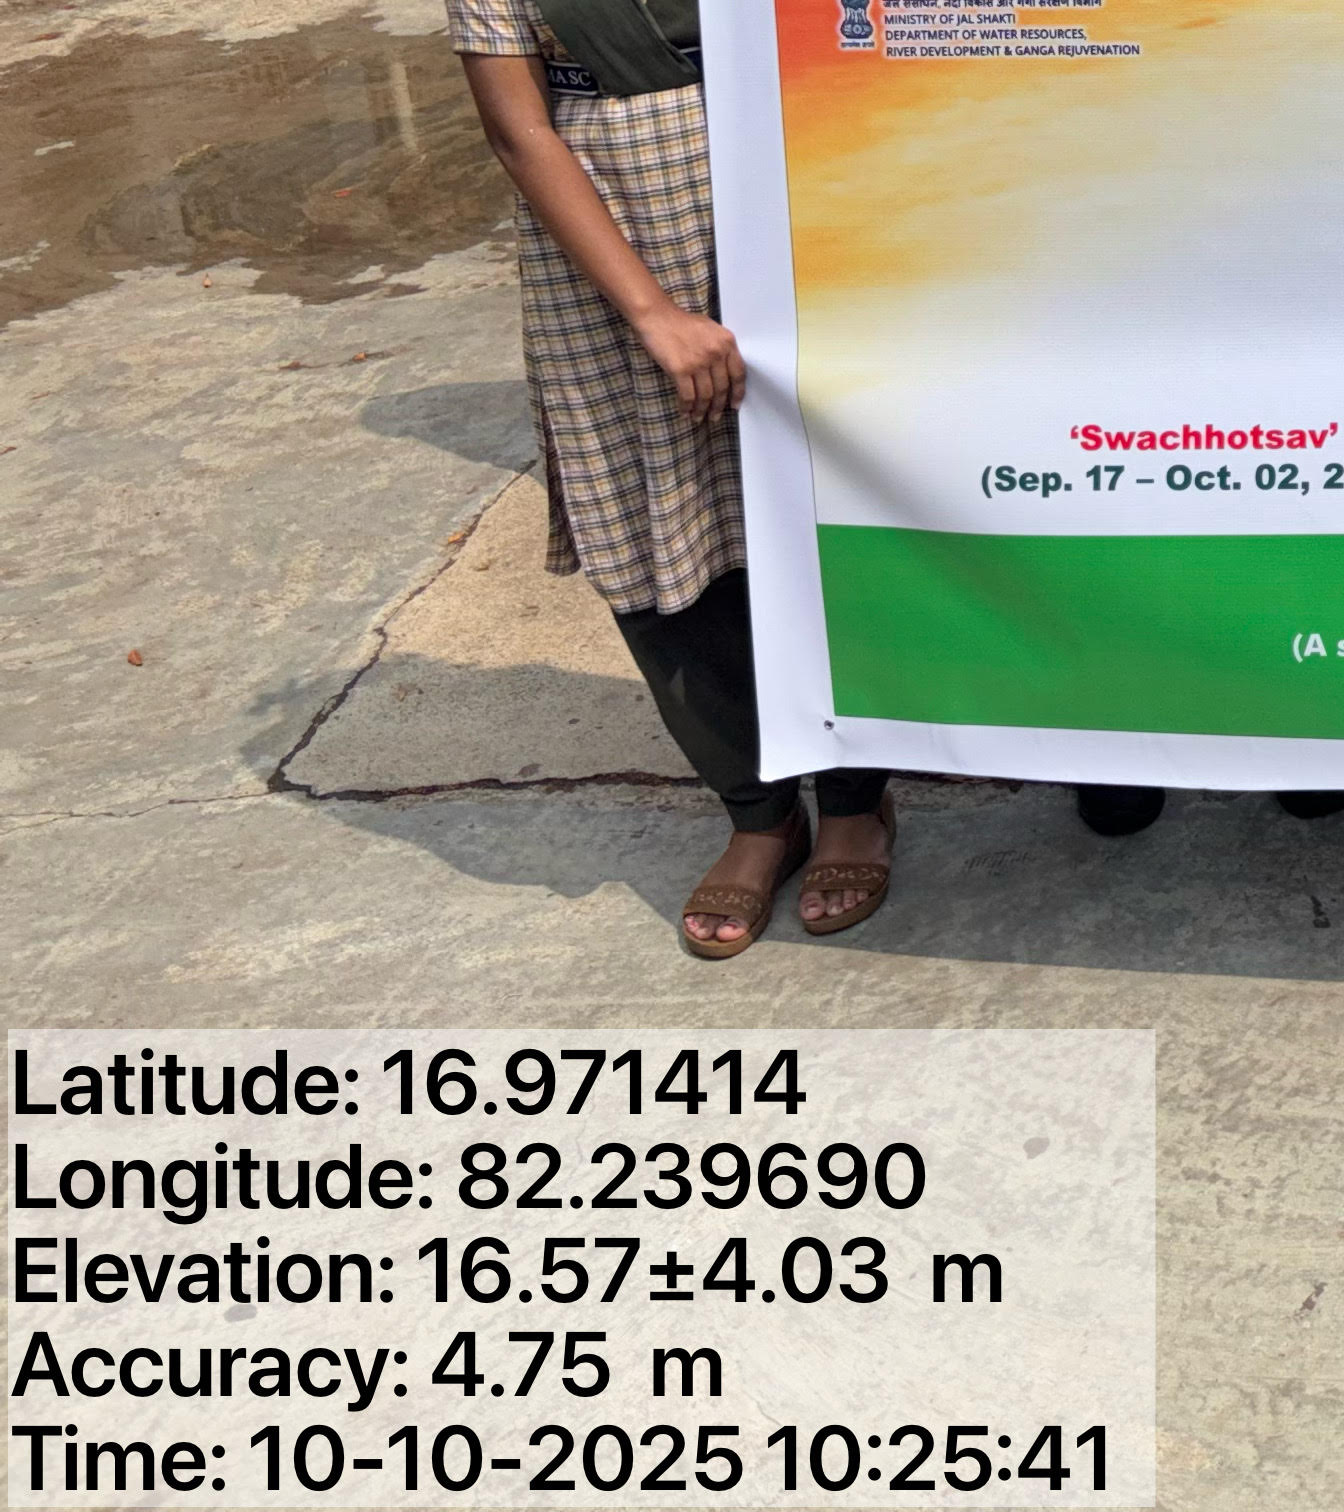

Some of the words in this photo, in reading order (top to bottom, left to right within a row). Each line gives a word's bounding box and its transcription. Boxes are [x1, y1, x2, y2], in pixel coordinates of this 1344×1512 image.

[884, 14, 938, 25] MINISTRY
[939, 14, 954, 25] OF
[956, 14, 974, 27] JAL
[976, 14, 1016, 24] SHAKTI
[885, 29, 960, 40] DEPARTMENT
[961, 29, 977, 40] OF
[979, 29, 1018, 40] WATER
[1020, 28, 1087, 41] RESOURCES,
[886, 46, 917, 57] RIVER
[920, 46, 1000, 57] DEVELOPMENT
[1003, 46, 1013, 56] &
[1015, 45, 1056, 56] GANGA
[1058, 45, 1140, 57] REJUVENATION
[981, 465, 1073, 498] (Sep.
[1086, 465, 1125, 490] 17
[1165, 464, 1242, 490] Oct.
[1255, 463, 1310, 495] 02,
[1292, 633, 1328, 663] (A
